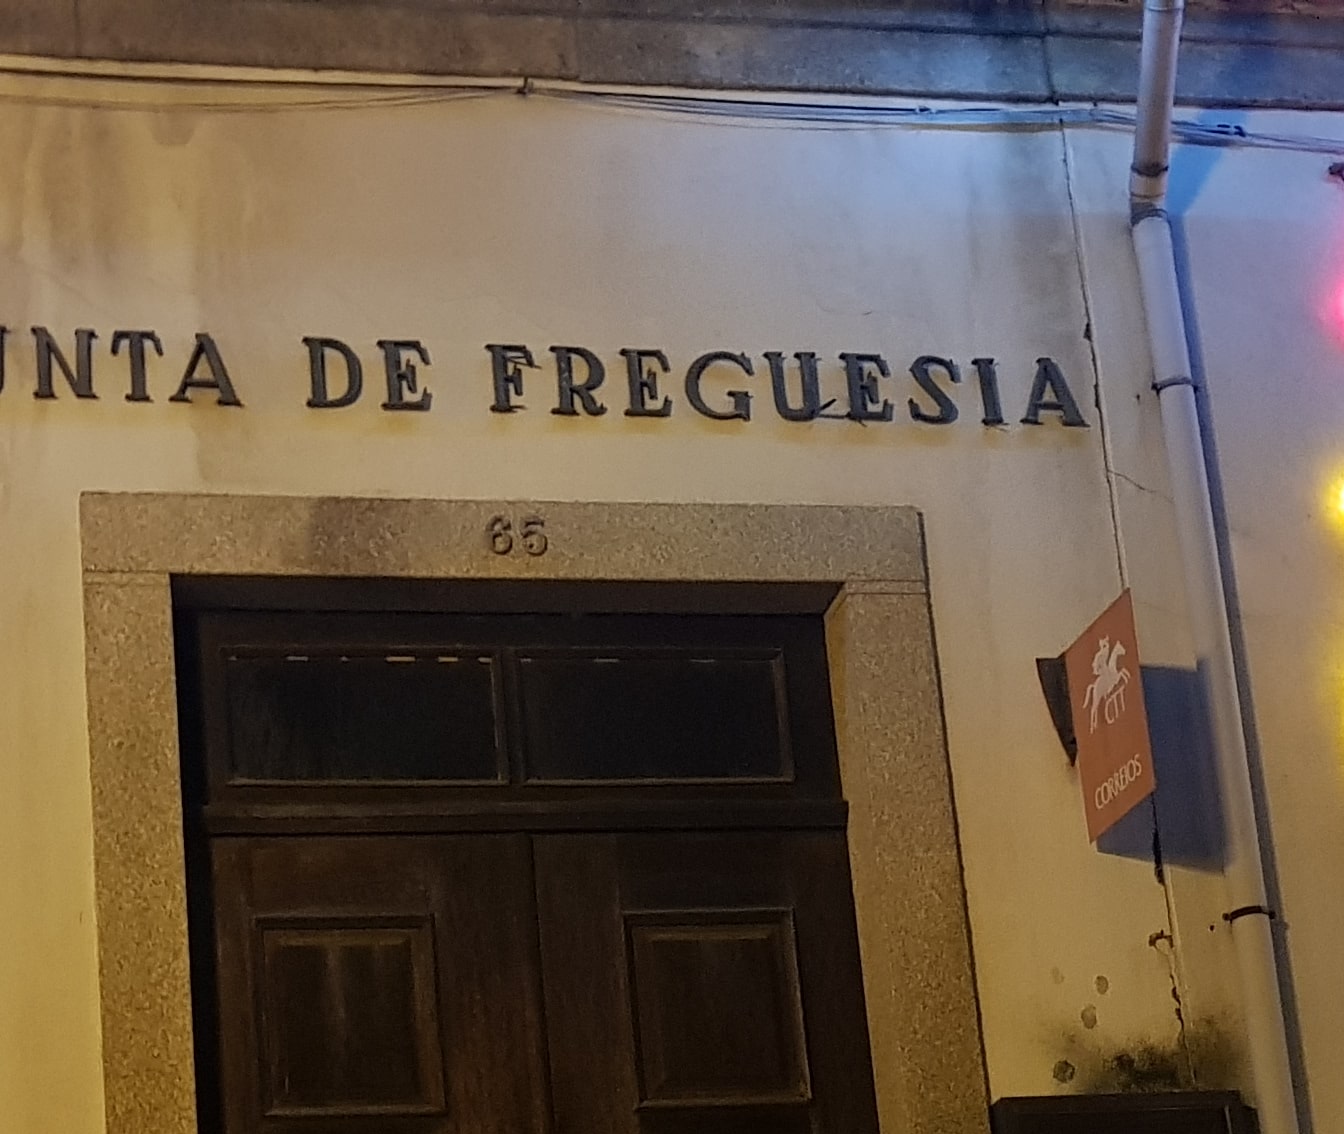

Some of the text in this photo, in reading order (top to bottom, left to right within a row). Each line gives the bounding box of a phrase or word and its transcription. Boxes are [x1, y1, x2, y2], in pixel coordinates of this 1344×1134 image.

[302, 336, 433, 412] DE
[484, 343, 1091, 428] FREGUESIA
[485, 515, 548, 557] 65
[1104, 684, 1127, 726] CTT
[1094, 753, 1143, 811] CORREIOS
